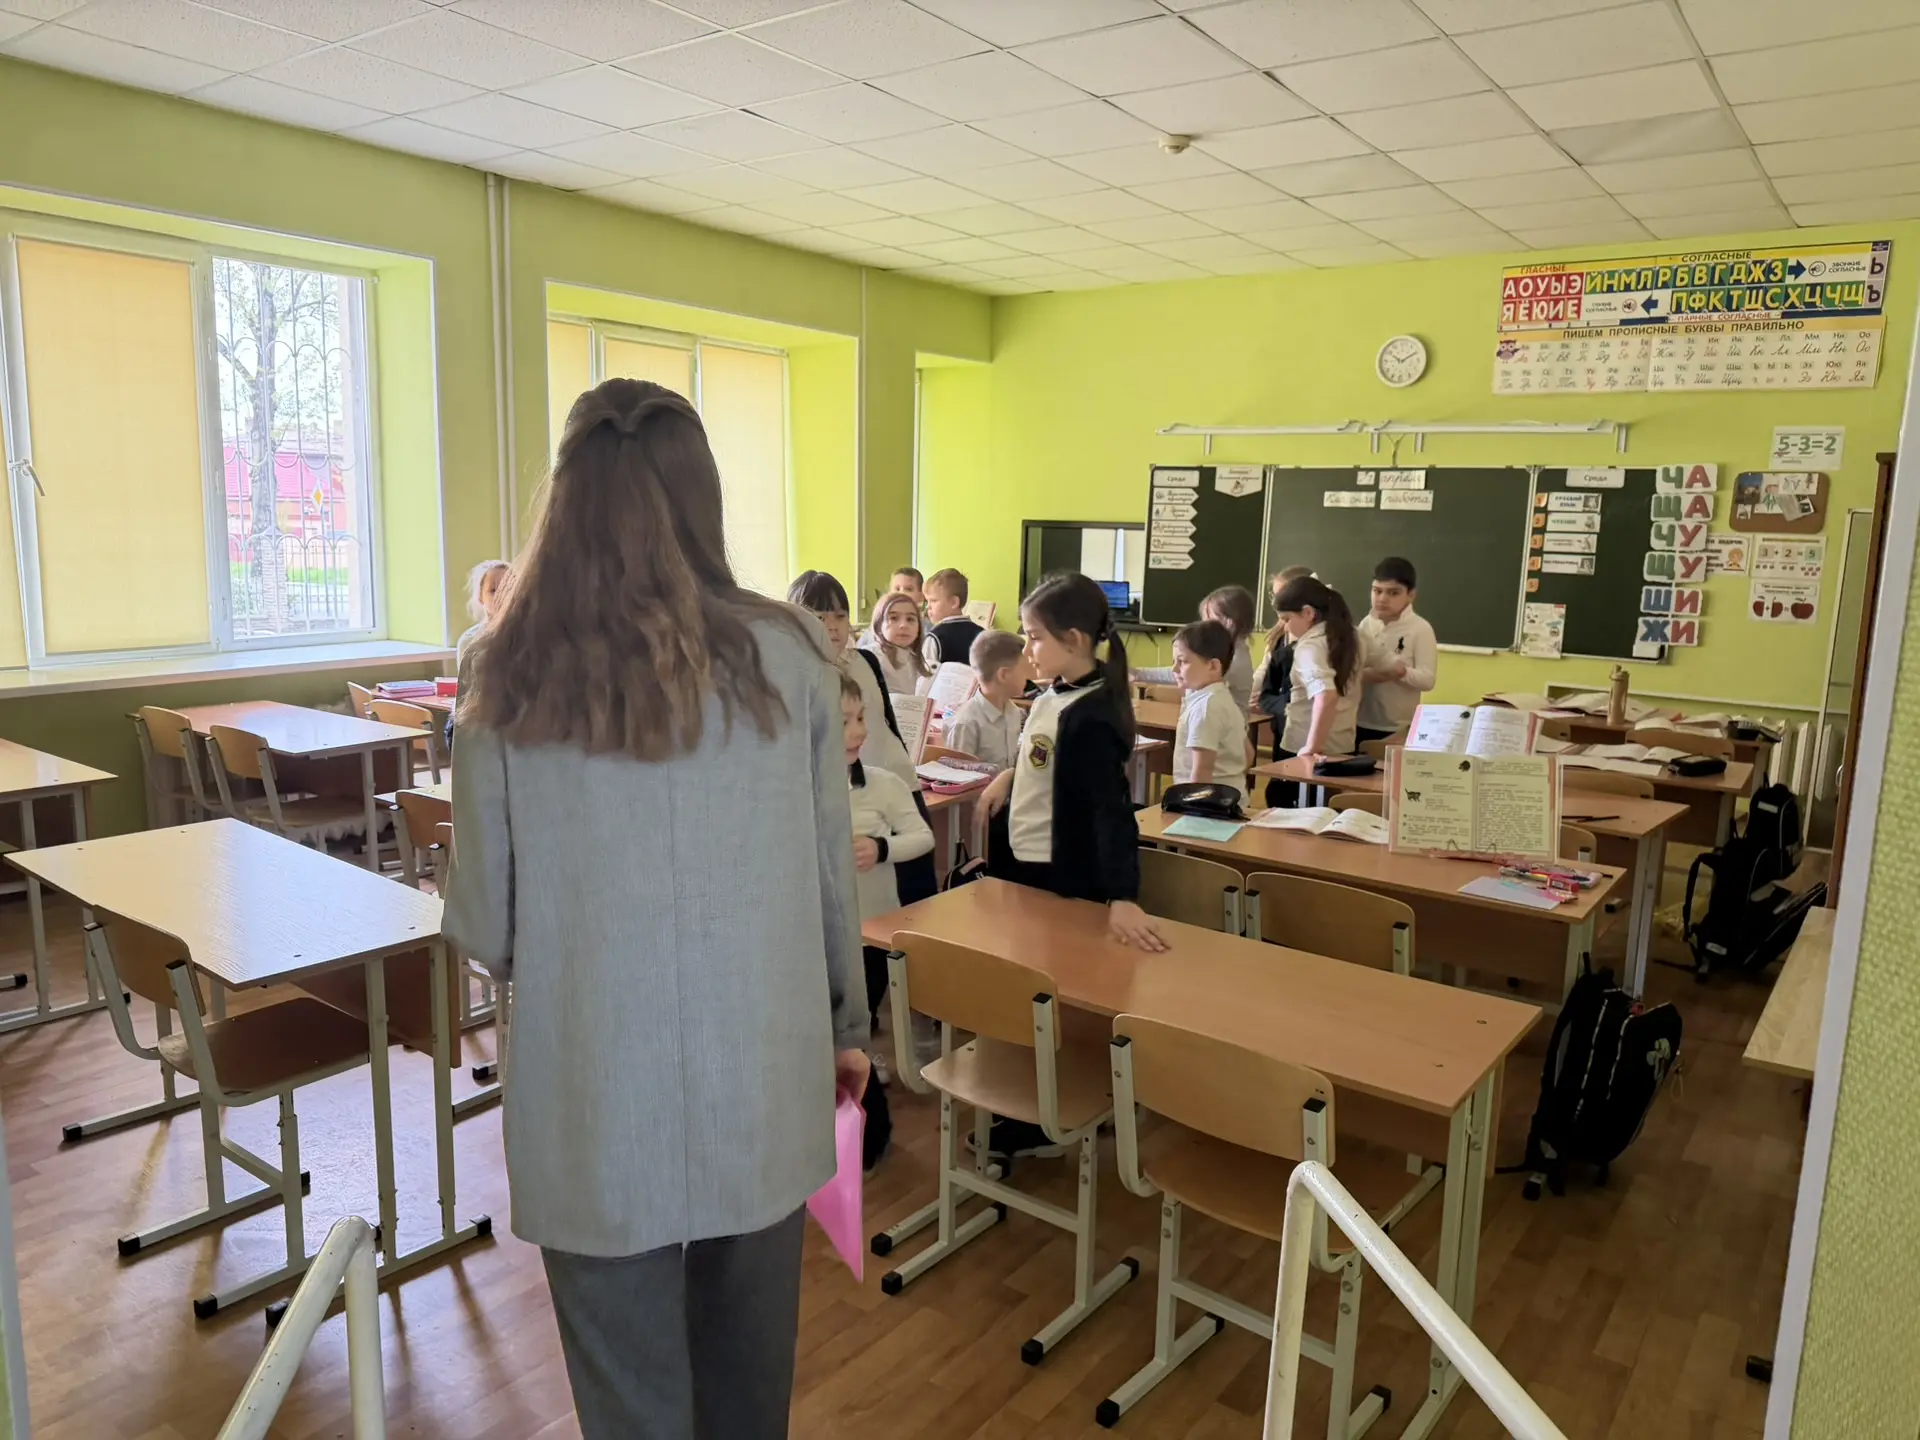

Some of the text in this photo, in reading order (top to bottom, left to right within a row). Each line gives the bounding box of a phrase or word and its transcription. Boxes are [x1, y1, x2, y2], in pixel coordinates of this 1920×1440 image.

[1682, 252, 1751, 263] СОГЛАСНЫЕ
[1520, 265, 1566, 275] ГЛАСНЫЕ
[1677, 312, 1771, 323] ПАРНЫЕ СОГЛАСНЫЕ
[1563, 321, 1804, 339] ПИШЕМ ПРОПИСНЫЕ БУКВЫ ПРАВИЛЬНО
[1167, 475, 1187, 483] Среда
[1584, 474, 1608, 482] Среда
[1662, 465, 1711, 489] ЧА
[1653, 495, 1710, 521] ЩА
[1653, 524, 1703, 548] ЧУ
[1646, 551, 1704, 580] ЩУ
[1643, 588, 1699, 614] ШИ
[1639, 619, 1696, 644] ЖИ
